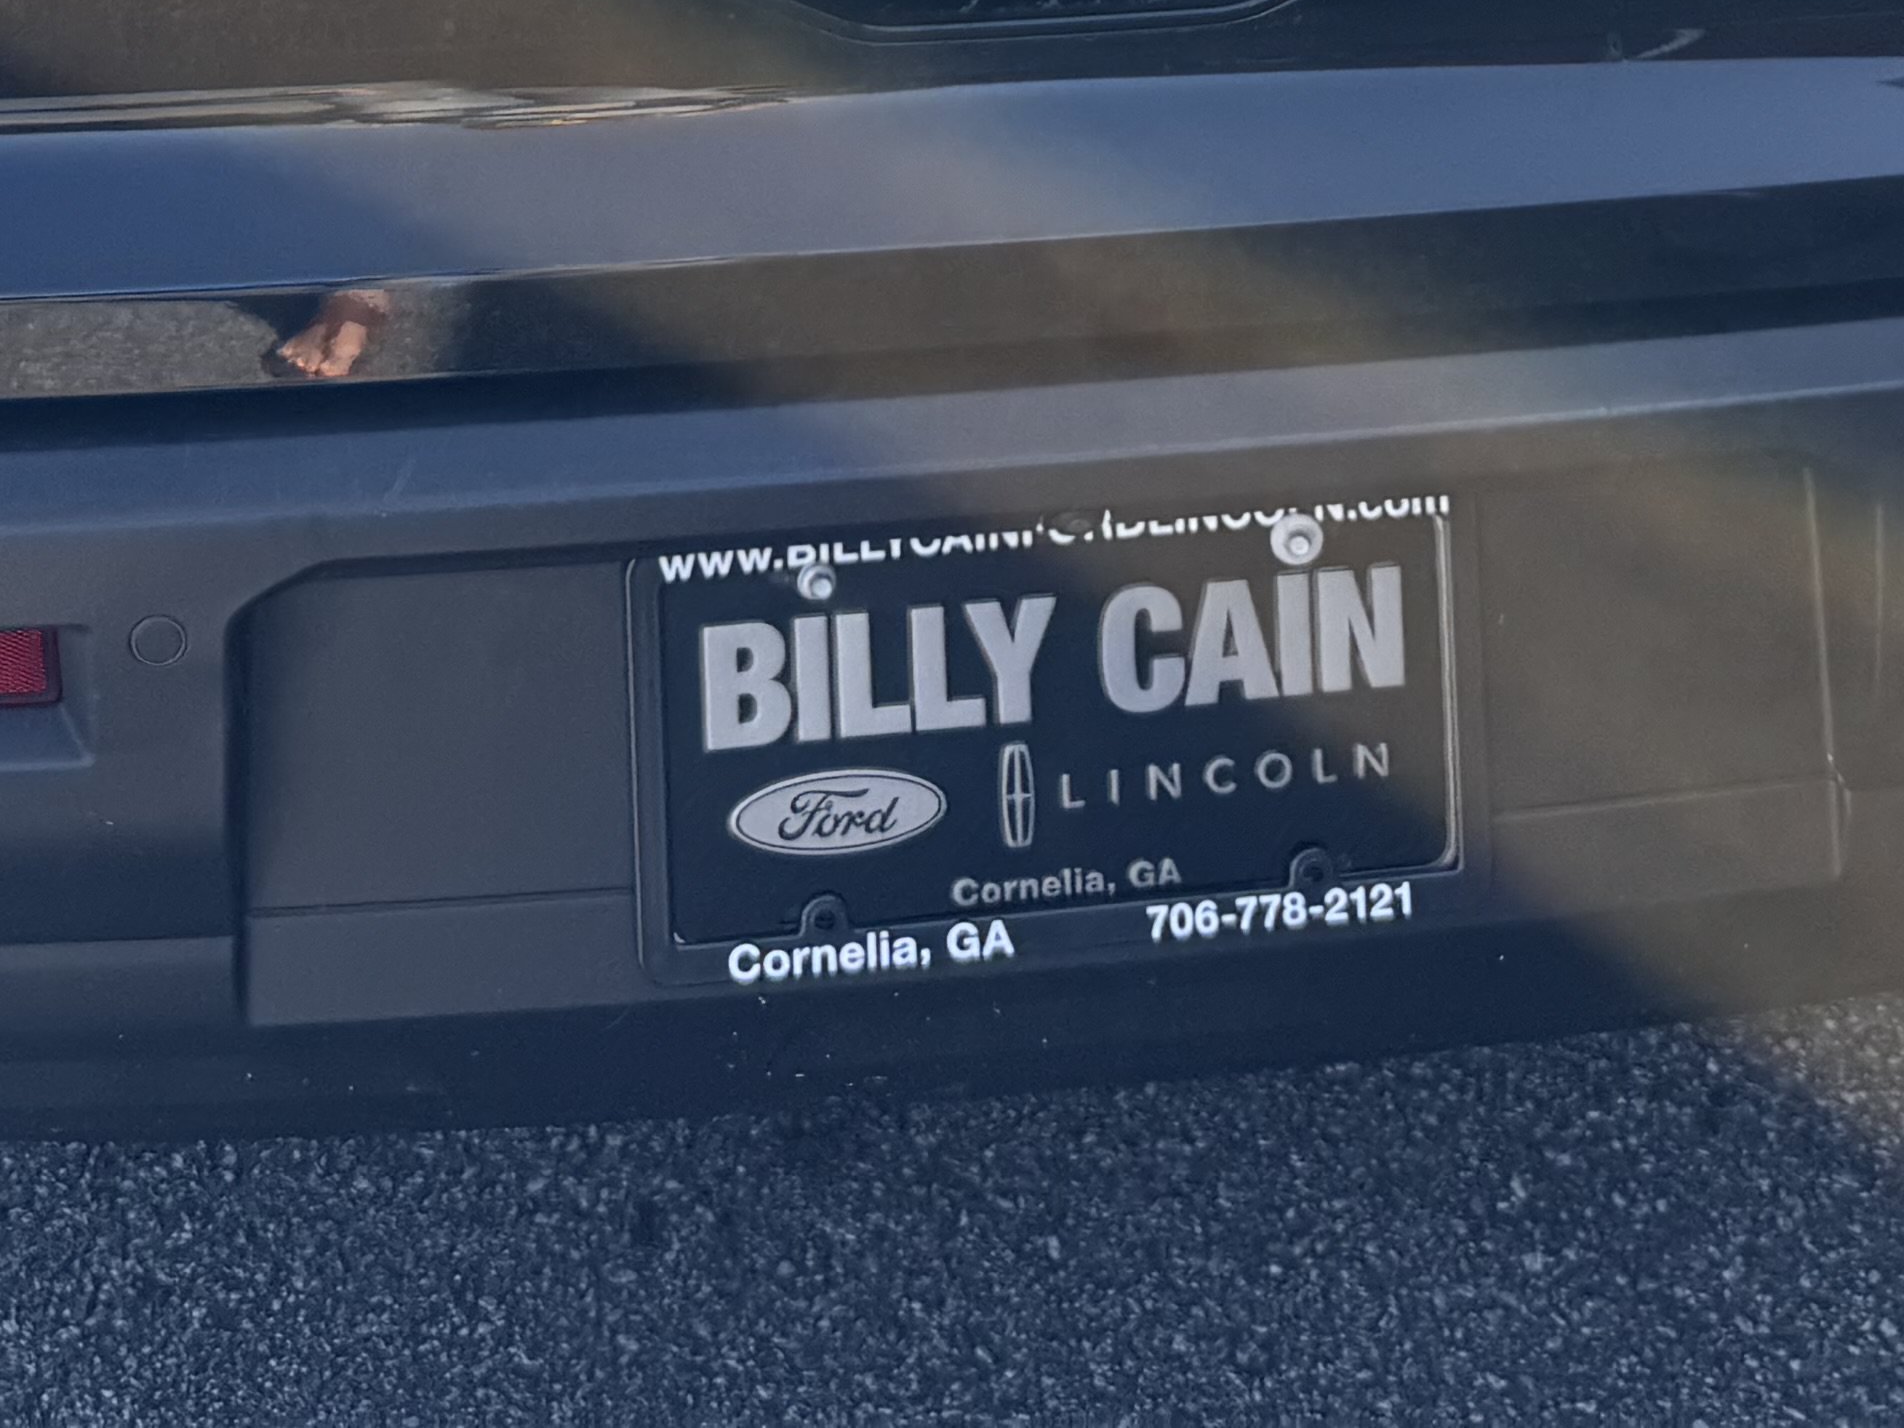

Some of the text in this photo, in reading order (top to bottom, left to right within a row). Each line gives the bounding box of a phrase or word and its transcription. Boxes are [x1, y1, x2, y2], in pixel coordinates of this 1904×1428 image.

[702, 563, 1406, 754] BILLY CAIN
[777, 742, 1392, 842] Ford LINCOLN
[951, 857, 1183, 907] Cornelia, GA
[1145, 880, 1415, 943] 706-778-2121
[726, 919, 1017, 985] Cornelia, GA
